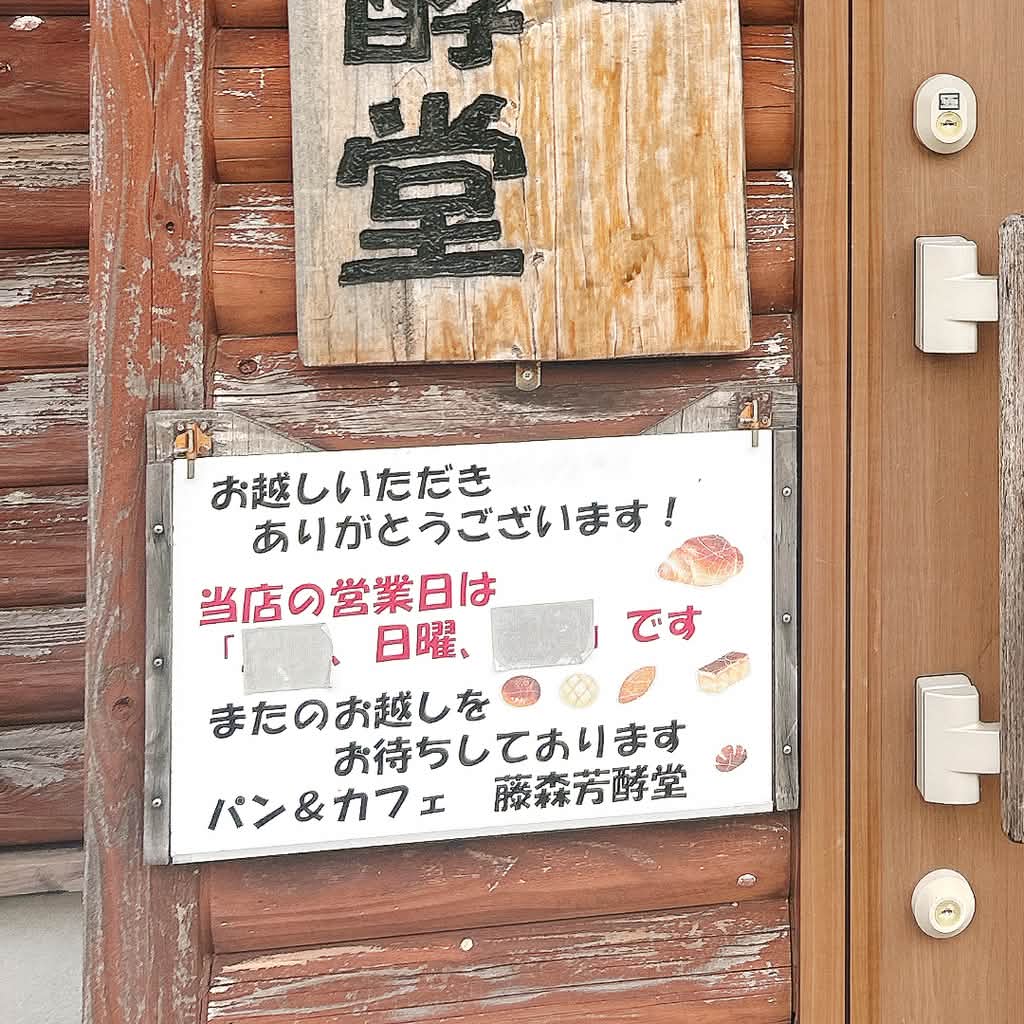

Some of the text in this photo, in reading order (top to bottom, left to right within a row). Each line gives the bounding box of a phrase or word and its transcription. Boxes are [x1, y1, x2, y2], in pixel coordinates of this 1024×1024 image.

[210, 464, 493, 511] お越しいただき
[252, 497, 678, 555] ありがとうございます!
[199, 571, 497, 626] 当店の営業日は
[627, 605, 703, 643] です
[209, 689, 491, 739] またのお越しを
[333, 720, 686, 777] お待ちしております
[208, 765, 688, 832] パン&カフェ 藤森芳酵堂
